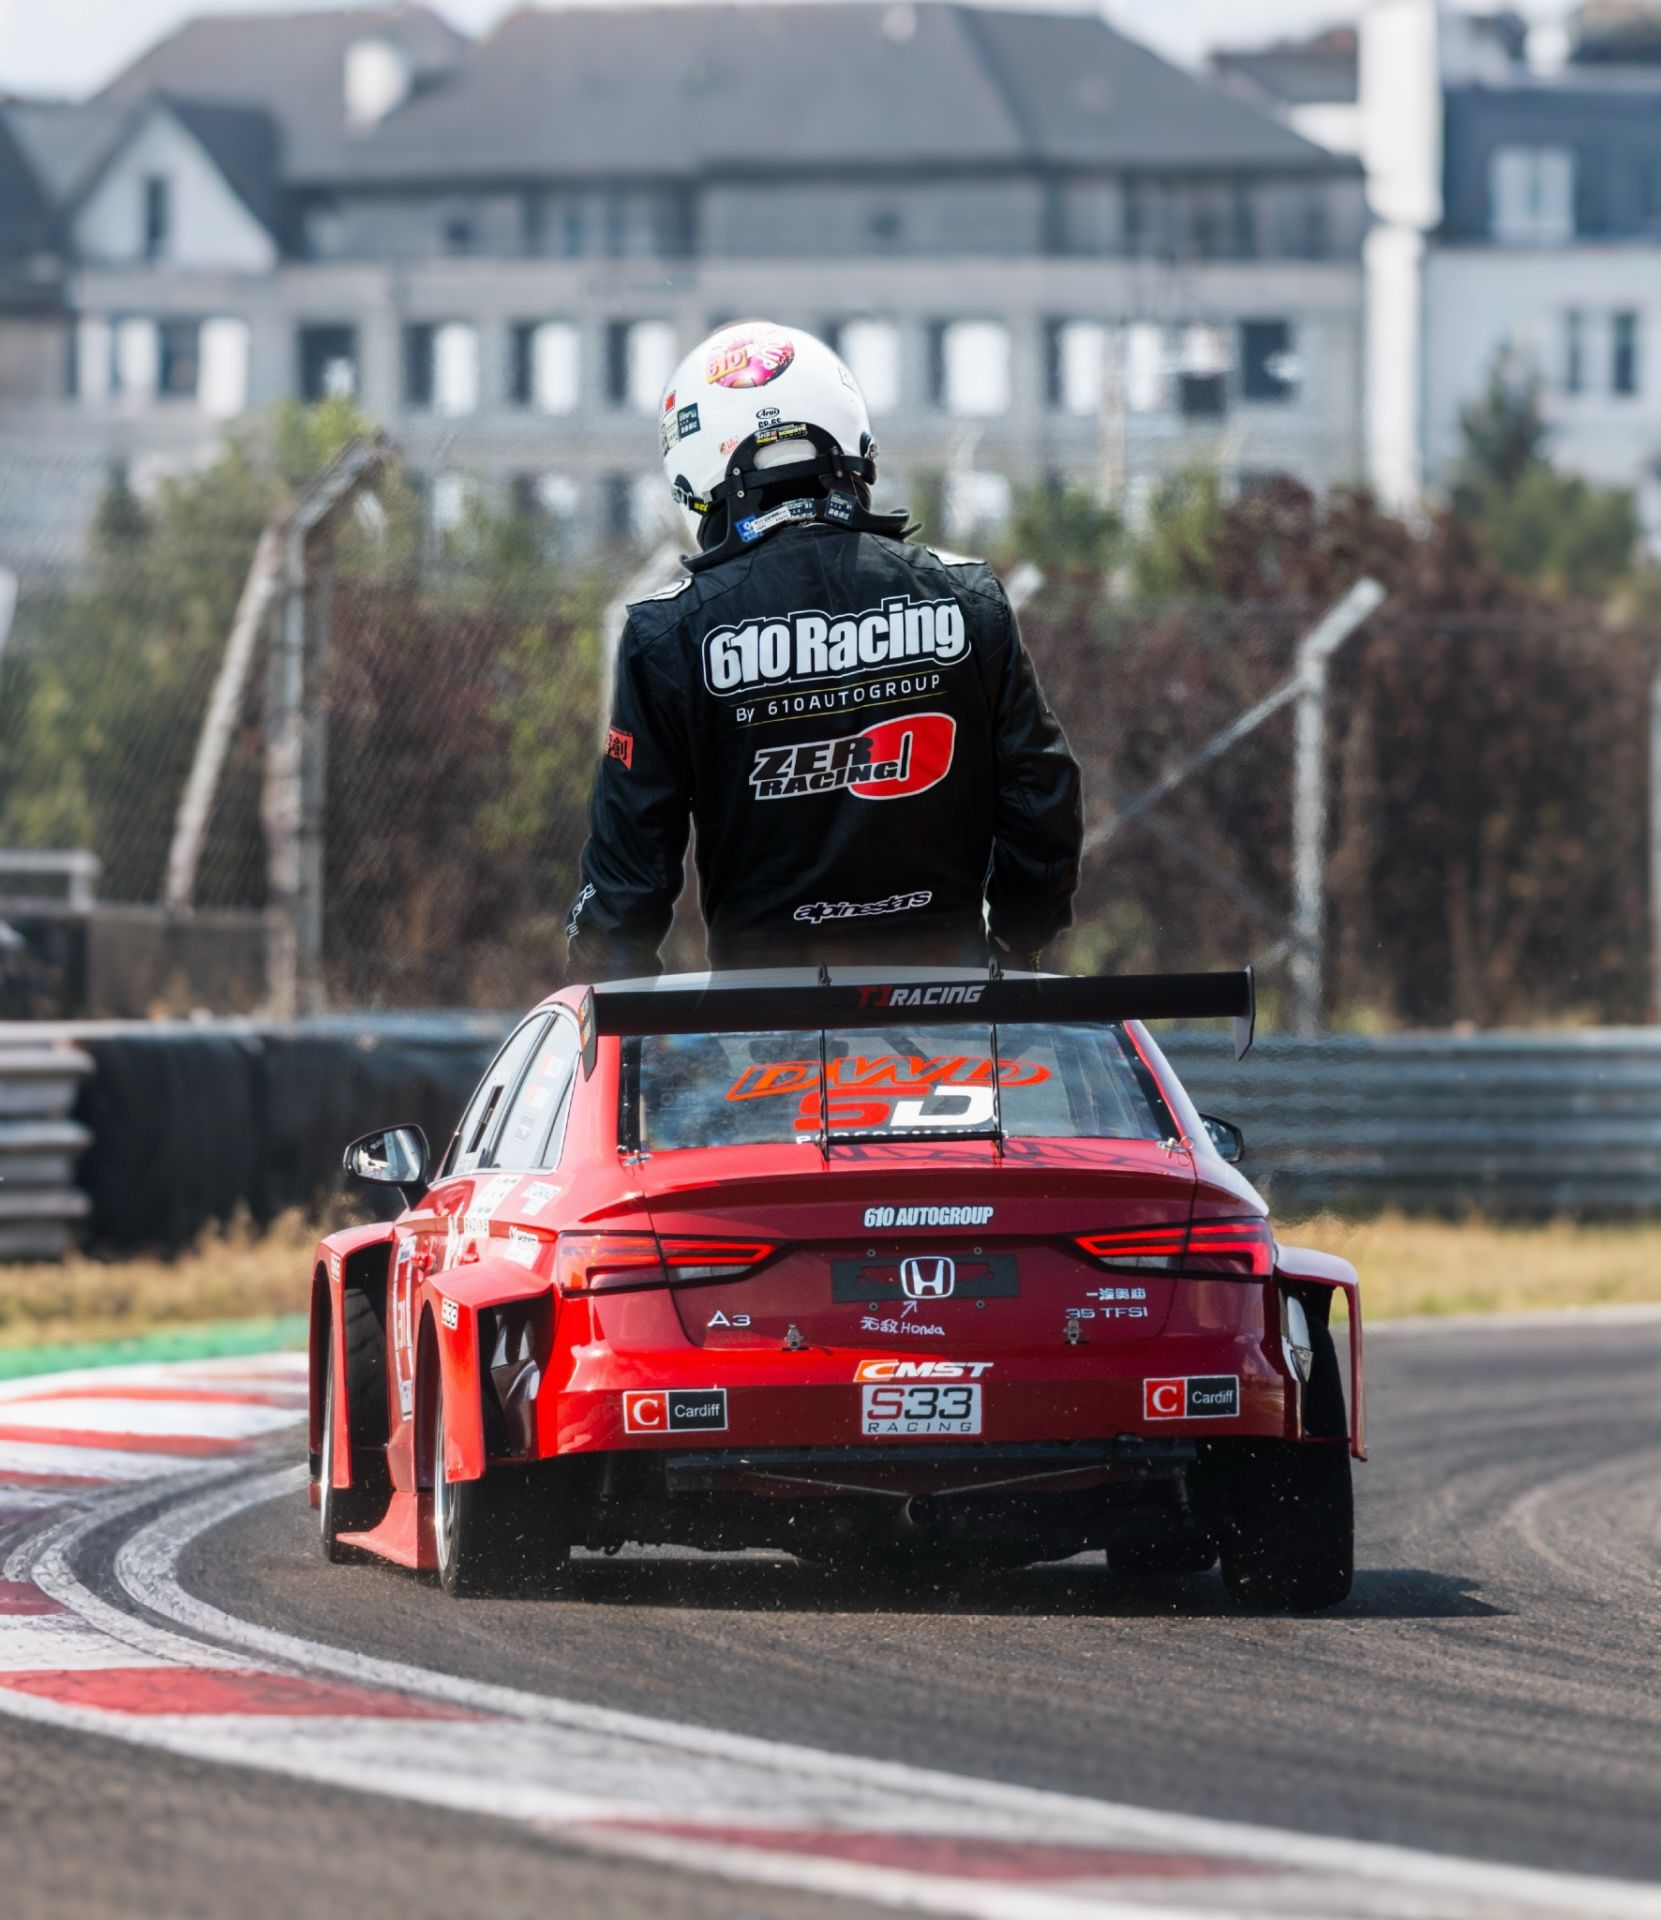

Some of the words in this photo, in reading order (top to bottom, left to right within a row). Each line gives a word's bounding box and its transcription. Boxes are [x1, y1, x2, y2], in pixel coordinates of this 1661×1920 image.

[709, 624, 790, 689] 610
[796, 603, 965, 674] Racing
[736, 707, 755, 722] By
[758, 761, 899, 797] RACING
[864, 1207, 895, 1227] 610
[895, 1206, 994, 1226] AUTOGROUP
[707, 1310, 751, 1327] A3
[1065, 1308, 1096, 1319] 35
[1100, 1306, 1148, 1318] TFSI
[862, 1361, 994, 1379] CMST
[1192, 1389, 1234, 1404] Cardiff
[674, 1403, 720, 1418] Cardiff
[867, 1421, 972, 1433] RACING
